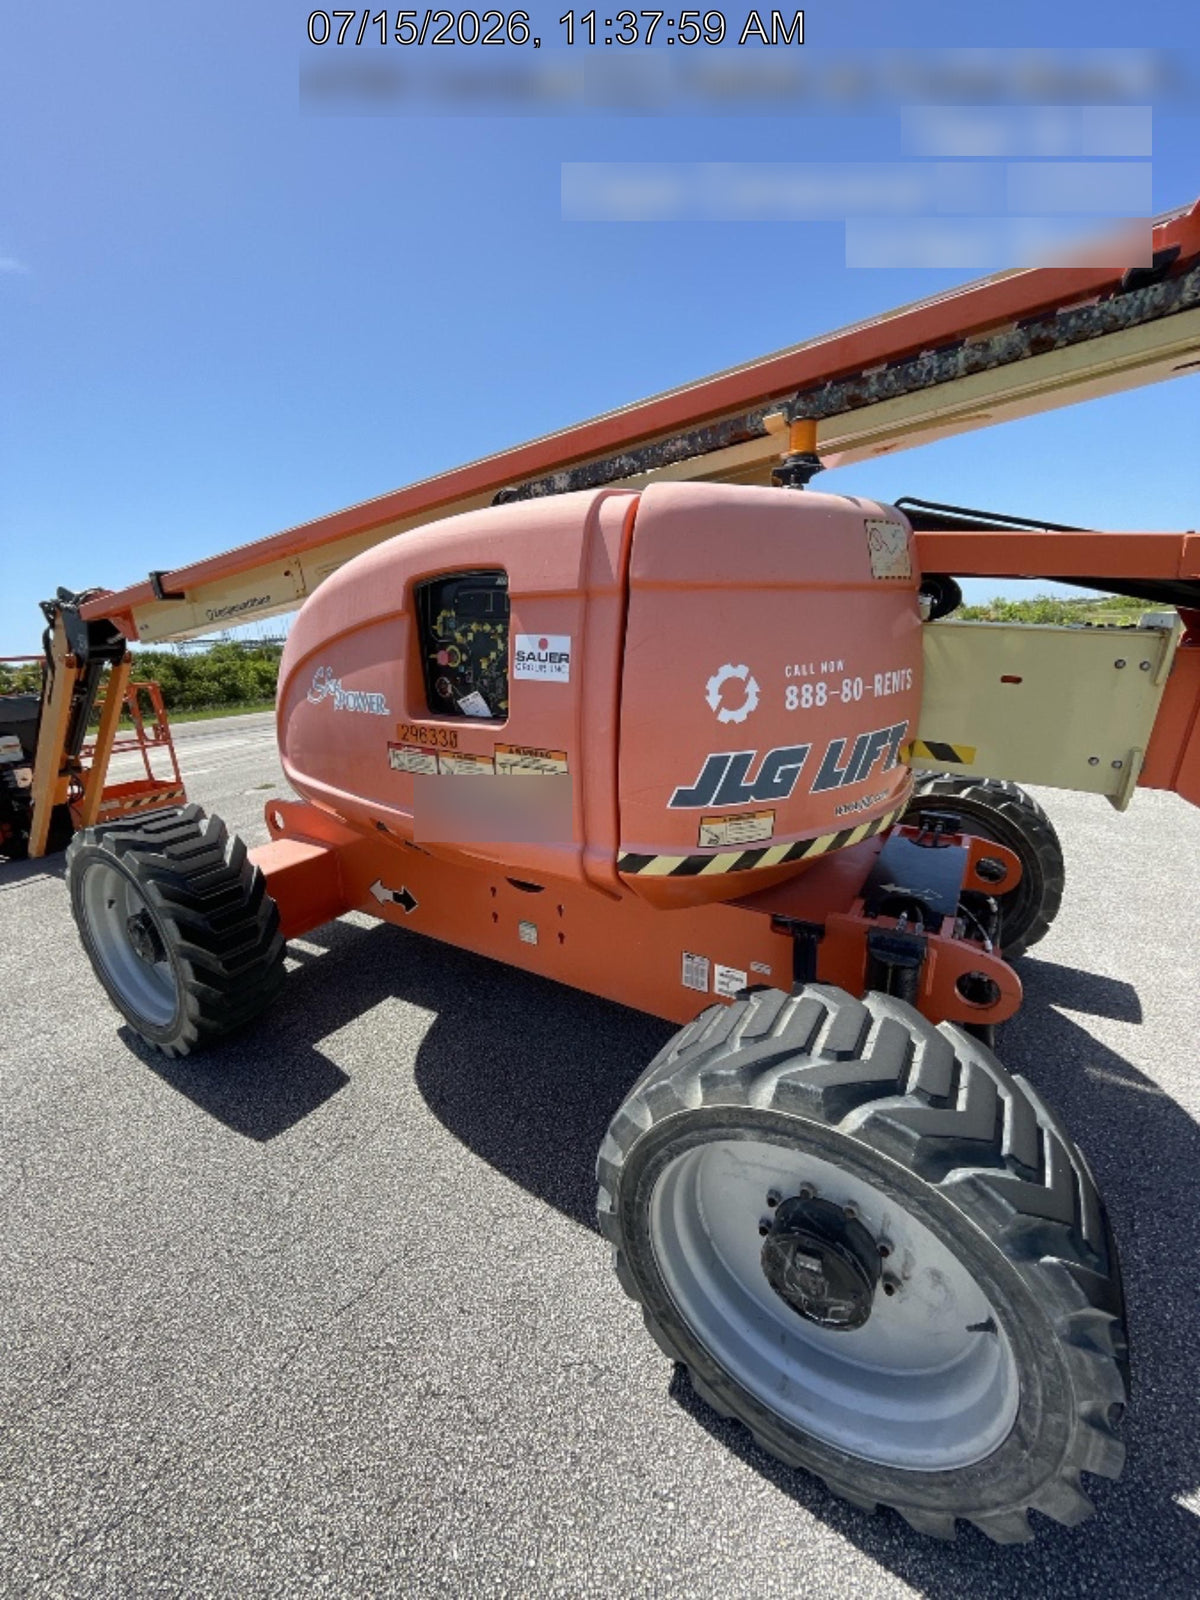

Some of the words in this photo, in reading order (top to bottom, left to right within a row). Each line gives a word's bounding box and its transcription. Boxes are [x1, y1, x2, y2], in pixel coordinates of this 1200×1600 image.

[516, 650, 570, 664] SAUER
[785, 663, 815, 678] CALL
[821, 659, 844, 674] NOW
[785, 667, 913, 710] 888-80-RENTS
[667, 743, 812, 809] JLG
[809, 720, 909, 794] LIFT
